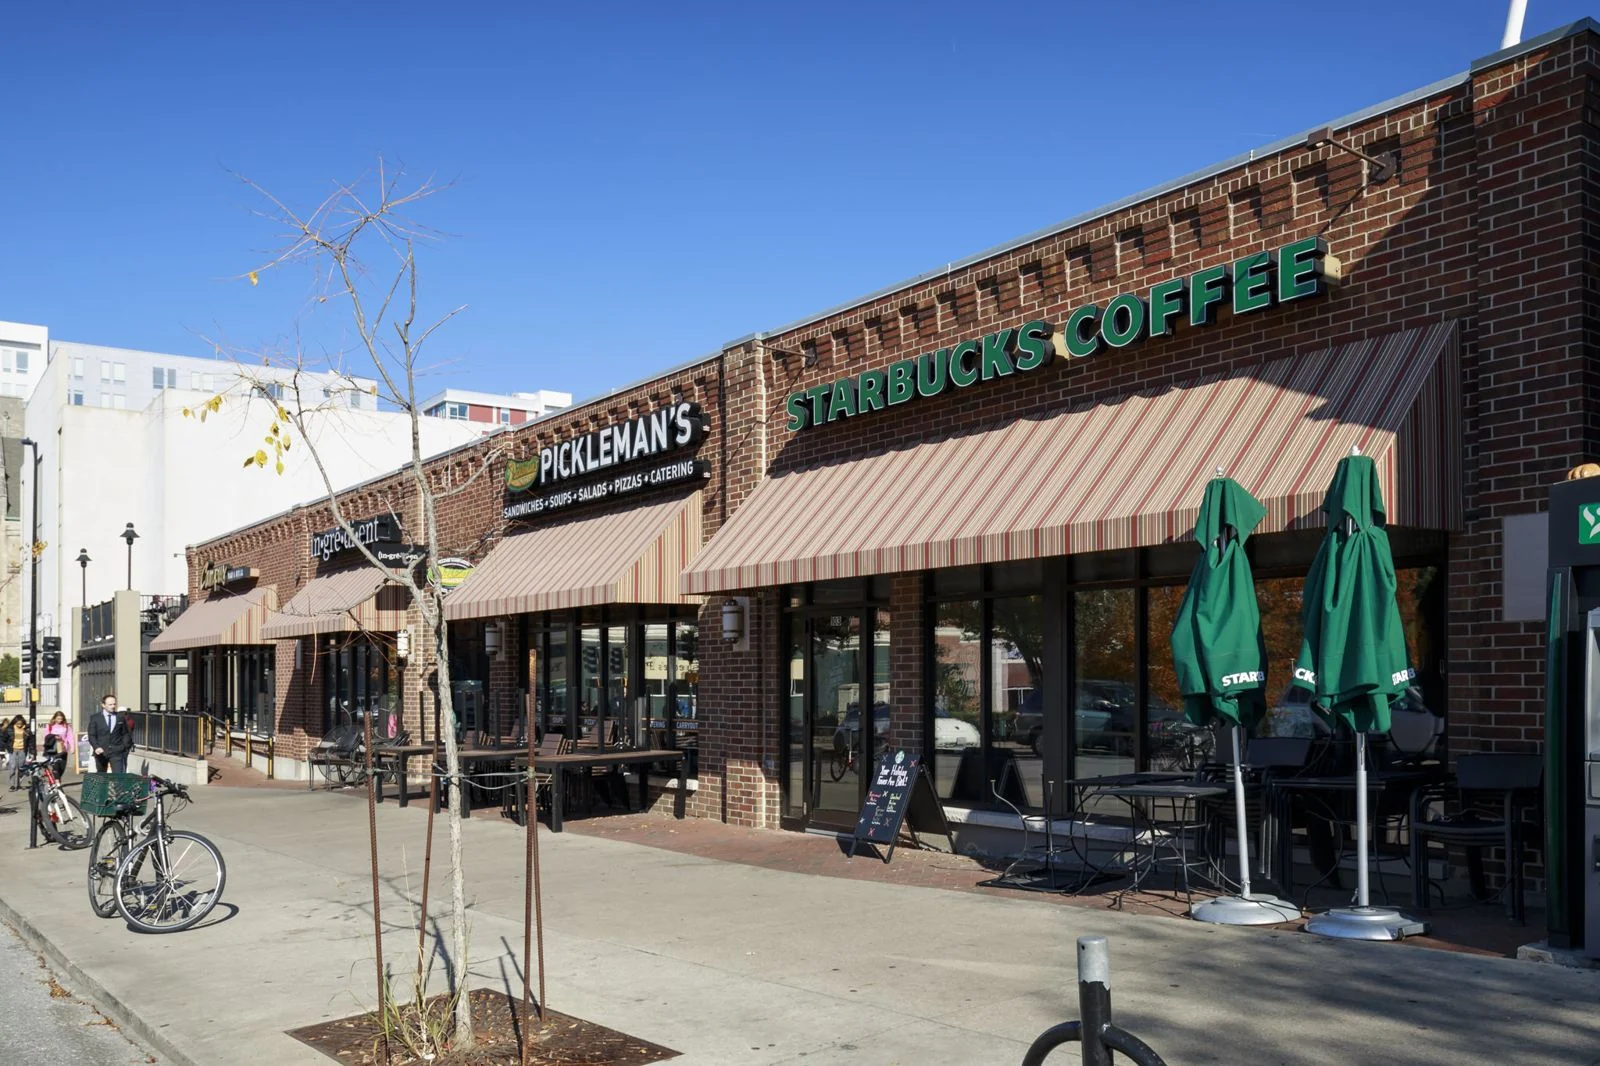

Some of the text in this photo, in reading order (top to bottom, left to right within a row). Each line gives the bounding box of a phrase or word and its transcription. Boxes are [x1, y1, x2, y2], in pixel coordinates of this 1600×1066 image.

[786, 236, 1320, 432] STARBUCKS COFFEE
[540, 402, 693, 484] PICKLEMAN'S
[503, 460, 694, 519] SANDWICHES SOUPS SALADS PIZZAS CATERING
